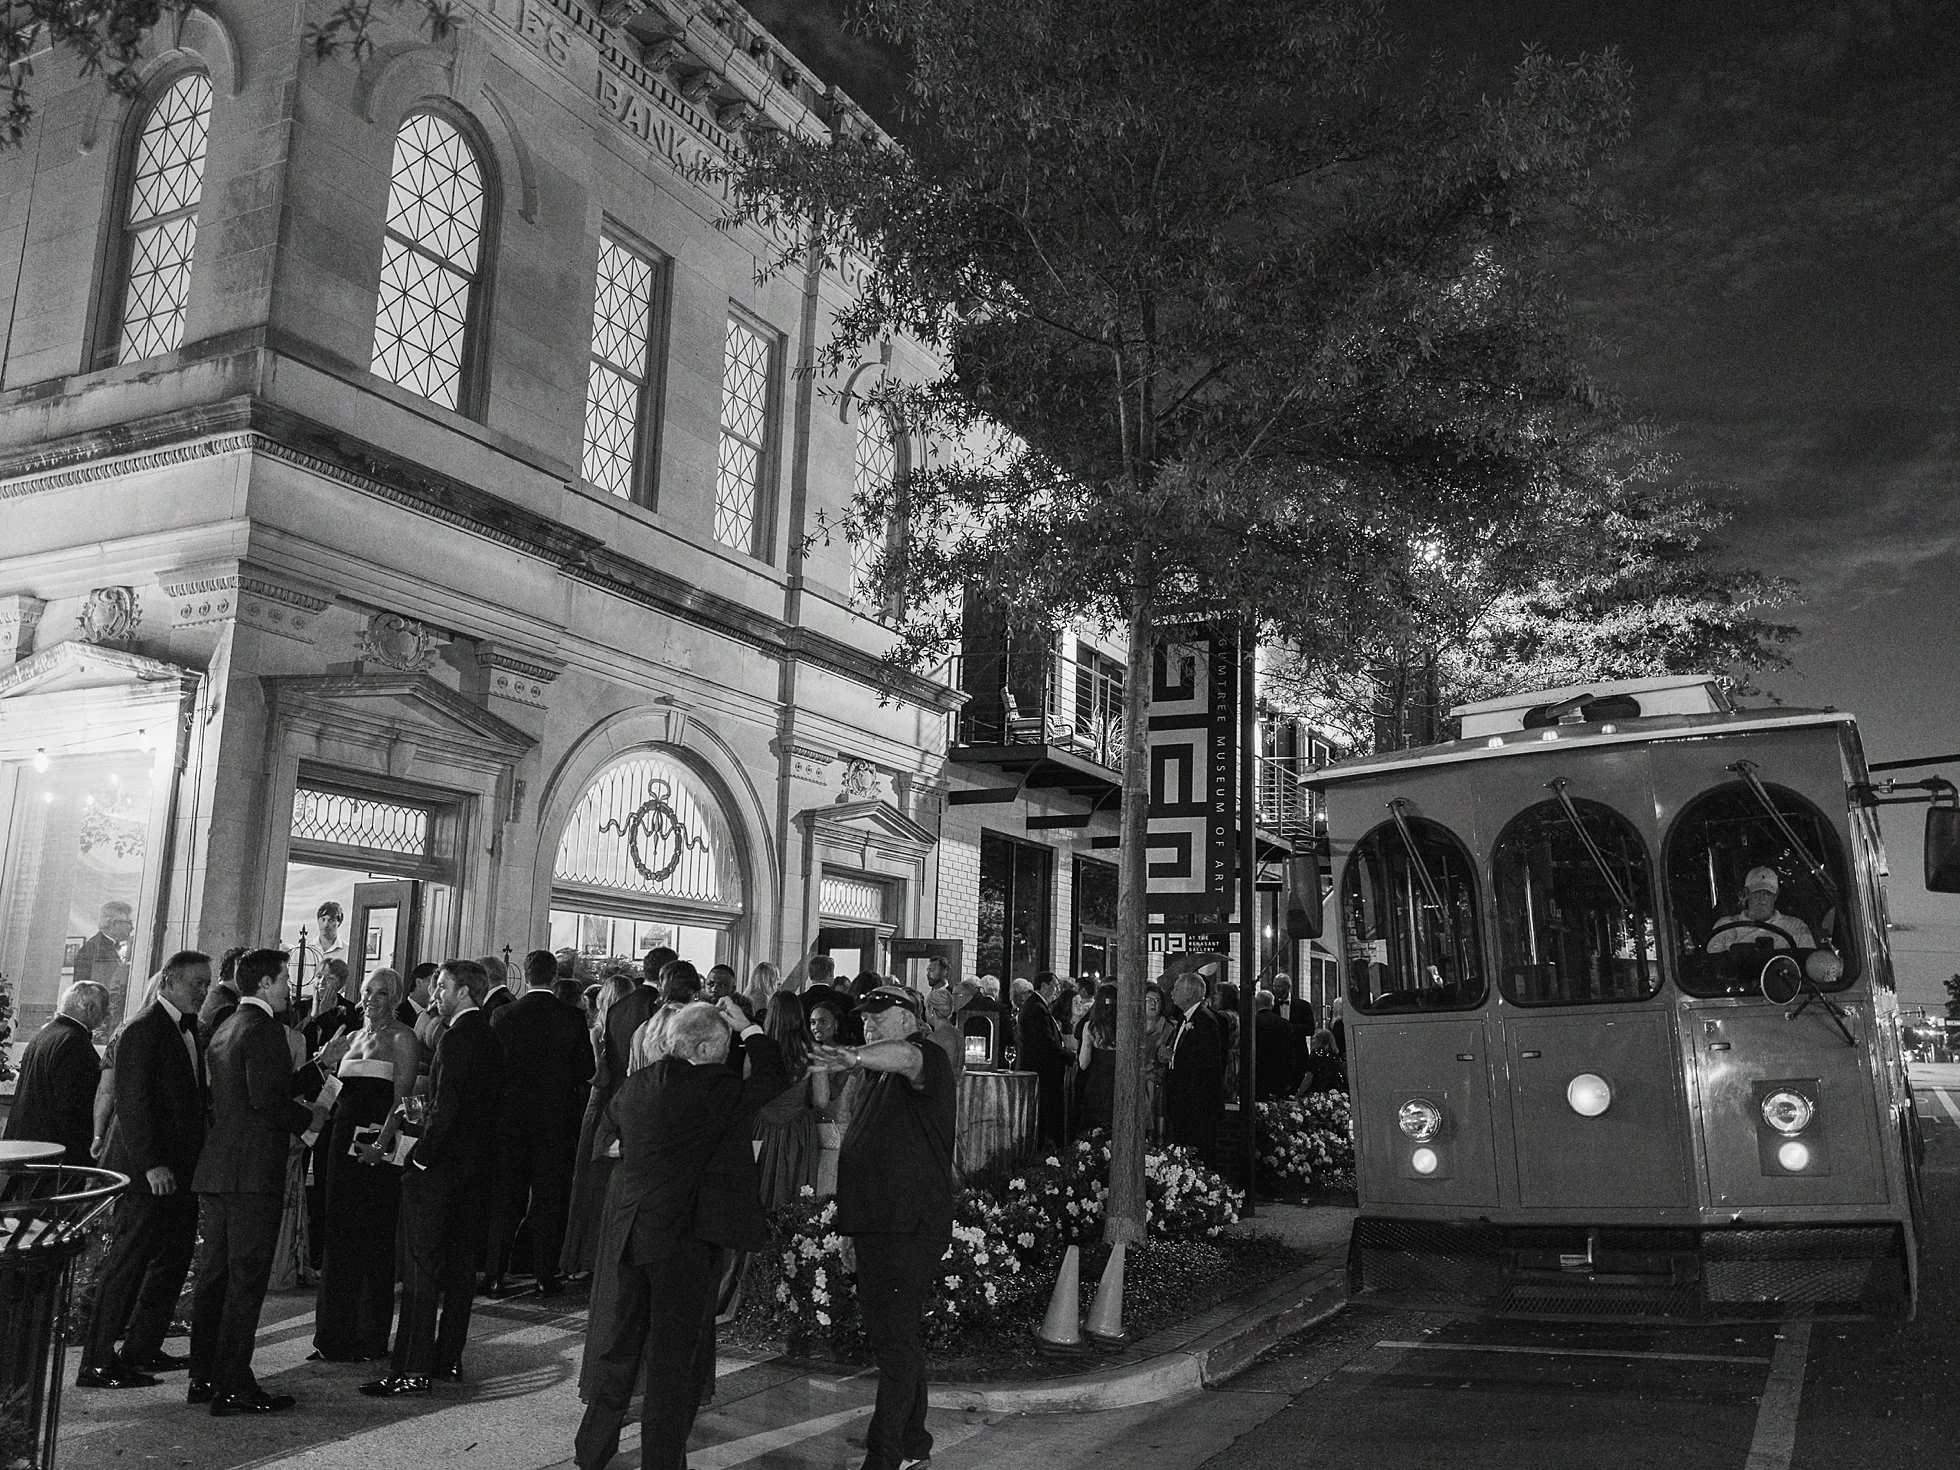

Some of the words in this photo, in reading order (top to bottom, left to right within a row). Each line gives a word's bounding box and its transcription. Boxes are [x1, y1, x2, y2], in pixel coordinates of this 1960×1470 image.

[597, 69, 691, 178] BANK
[1216, 638, 1228, 723] GUMTREE
[1215, 735, 1227, 814] MUSEUM
[1215, 826, 1226, 848] OF
[1214, 860, 1225, 894] ART
